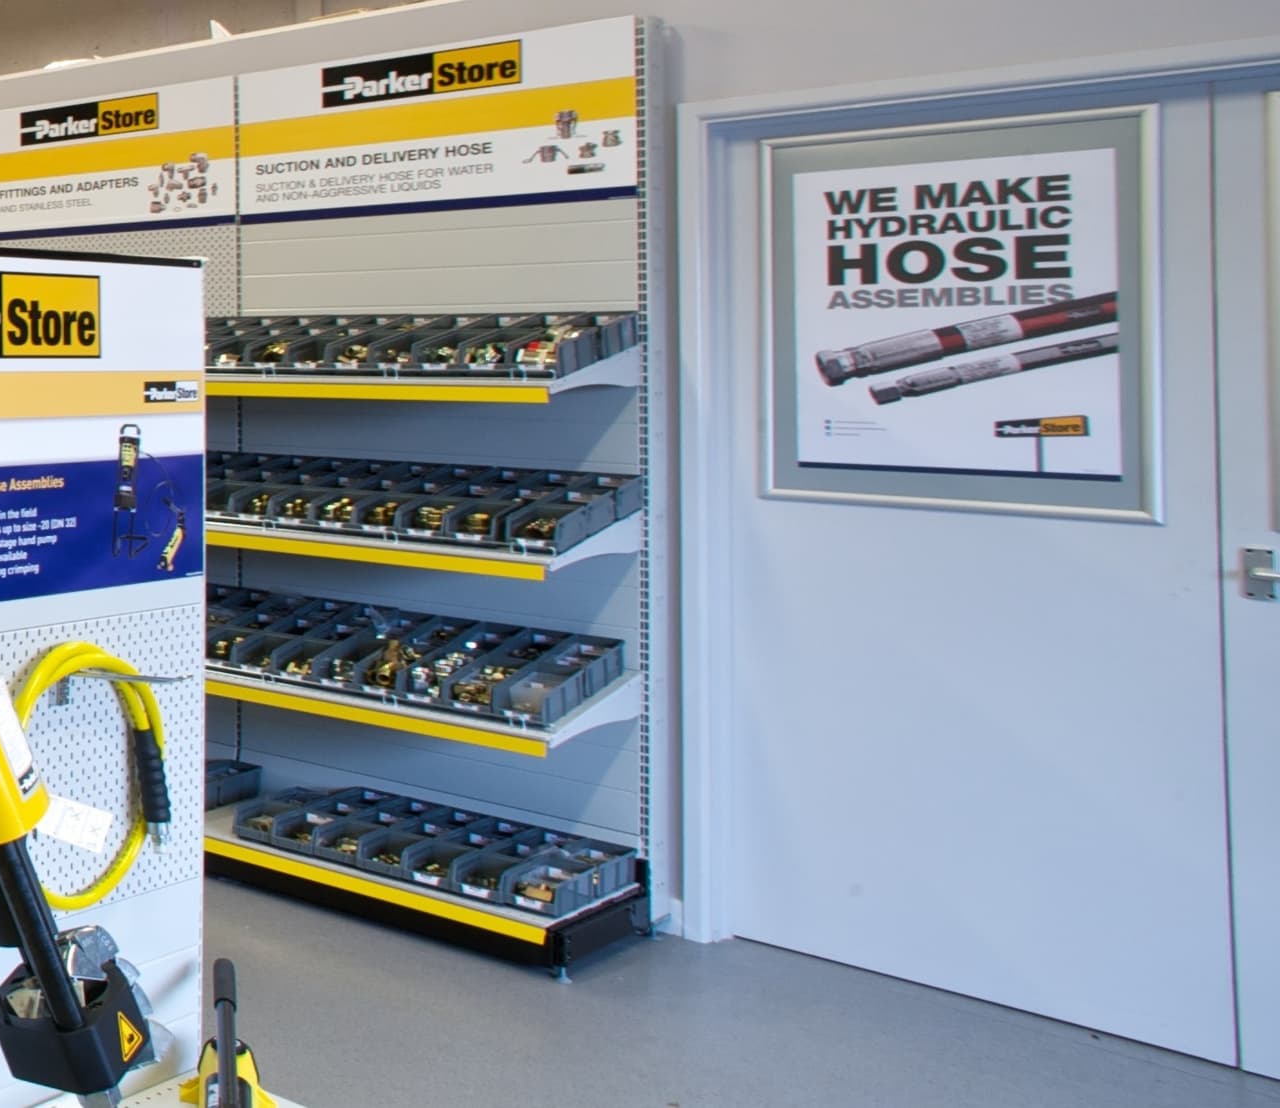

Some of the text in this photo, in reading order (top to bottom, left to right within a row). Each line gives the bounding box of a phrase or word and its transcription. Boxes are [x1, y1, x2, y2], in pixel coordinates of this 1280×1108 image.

[437, 57, 517, 87] Store
[101, 109, 155, 130] Store
[256, 142, 493, 175] SUCTION AND DELIVERY HOSE
[49, 182, 73, 195] AND
[77, 176, 139, 192] ADAPTERS
[256, 163, 493, 193] SUCTION & DELIVERY HOSE FOR WATER
[256, 179, 441, 203] AND NON-AGGRESSIVE LIQUIDS
[824, 174, 1071, 215] WE MAKE
[0, 204, 16, 214] AND
[19, 200, 64, 213] STAINLESS
[66, 199, 92, 208] STEEL
[826, 204, 1073, 241] HYDRAULIC
[827, 233, 1073, 286] HOSE
[826, 283, 1075, 310] ASSEMBLIES
[7, 298, 96, 346] Store
[1043, 423, 1081, 433] Store
[9, 475, 64, 491] Assemblies
[7, 508, 20, 519] the
[21, 507, 37, 518] field
[2, 525, 12, 535] up
[13, 523, 21, 532] to
[22, 521, 37, 532] size
[18, 534, 36, 546] hand
[37, 534, 57, 546] pump
[7, 563, 40, 575] crimping
